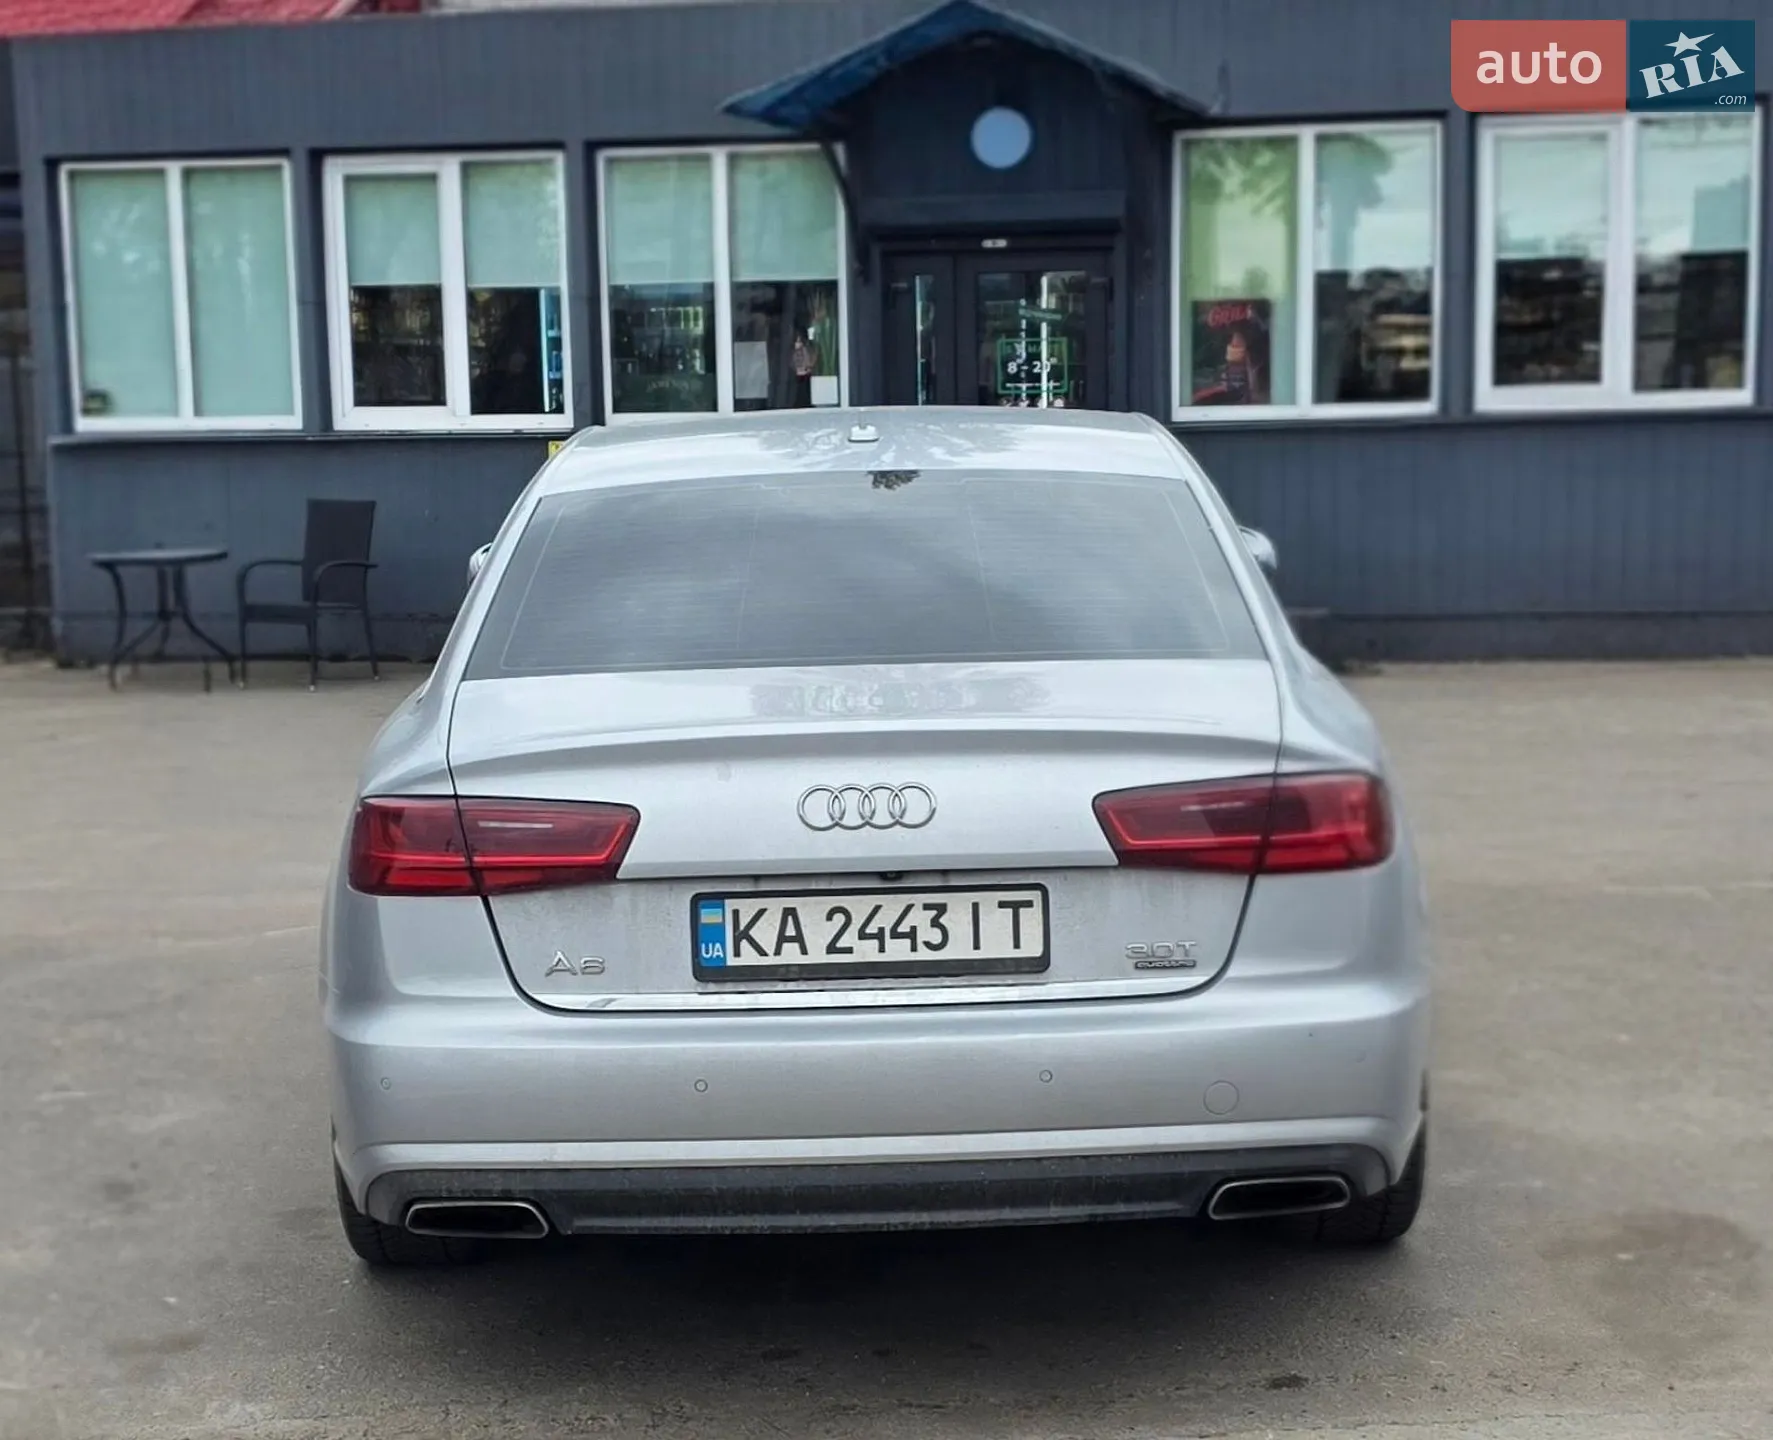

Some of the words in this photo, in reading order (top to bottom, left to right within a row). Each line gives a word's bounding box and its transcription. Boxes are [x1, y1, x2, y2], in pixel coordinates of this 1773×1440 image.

[731, 907, 809, 958] KA
[825, 902, 950, 955] 2443
[971, 900, 1034, 951] IT
[545, 949, 605, 977] A6
[701, 942, 724, 958] UA
